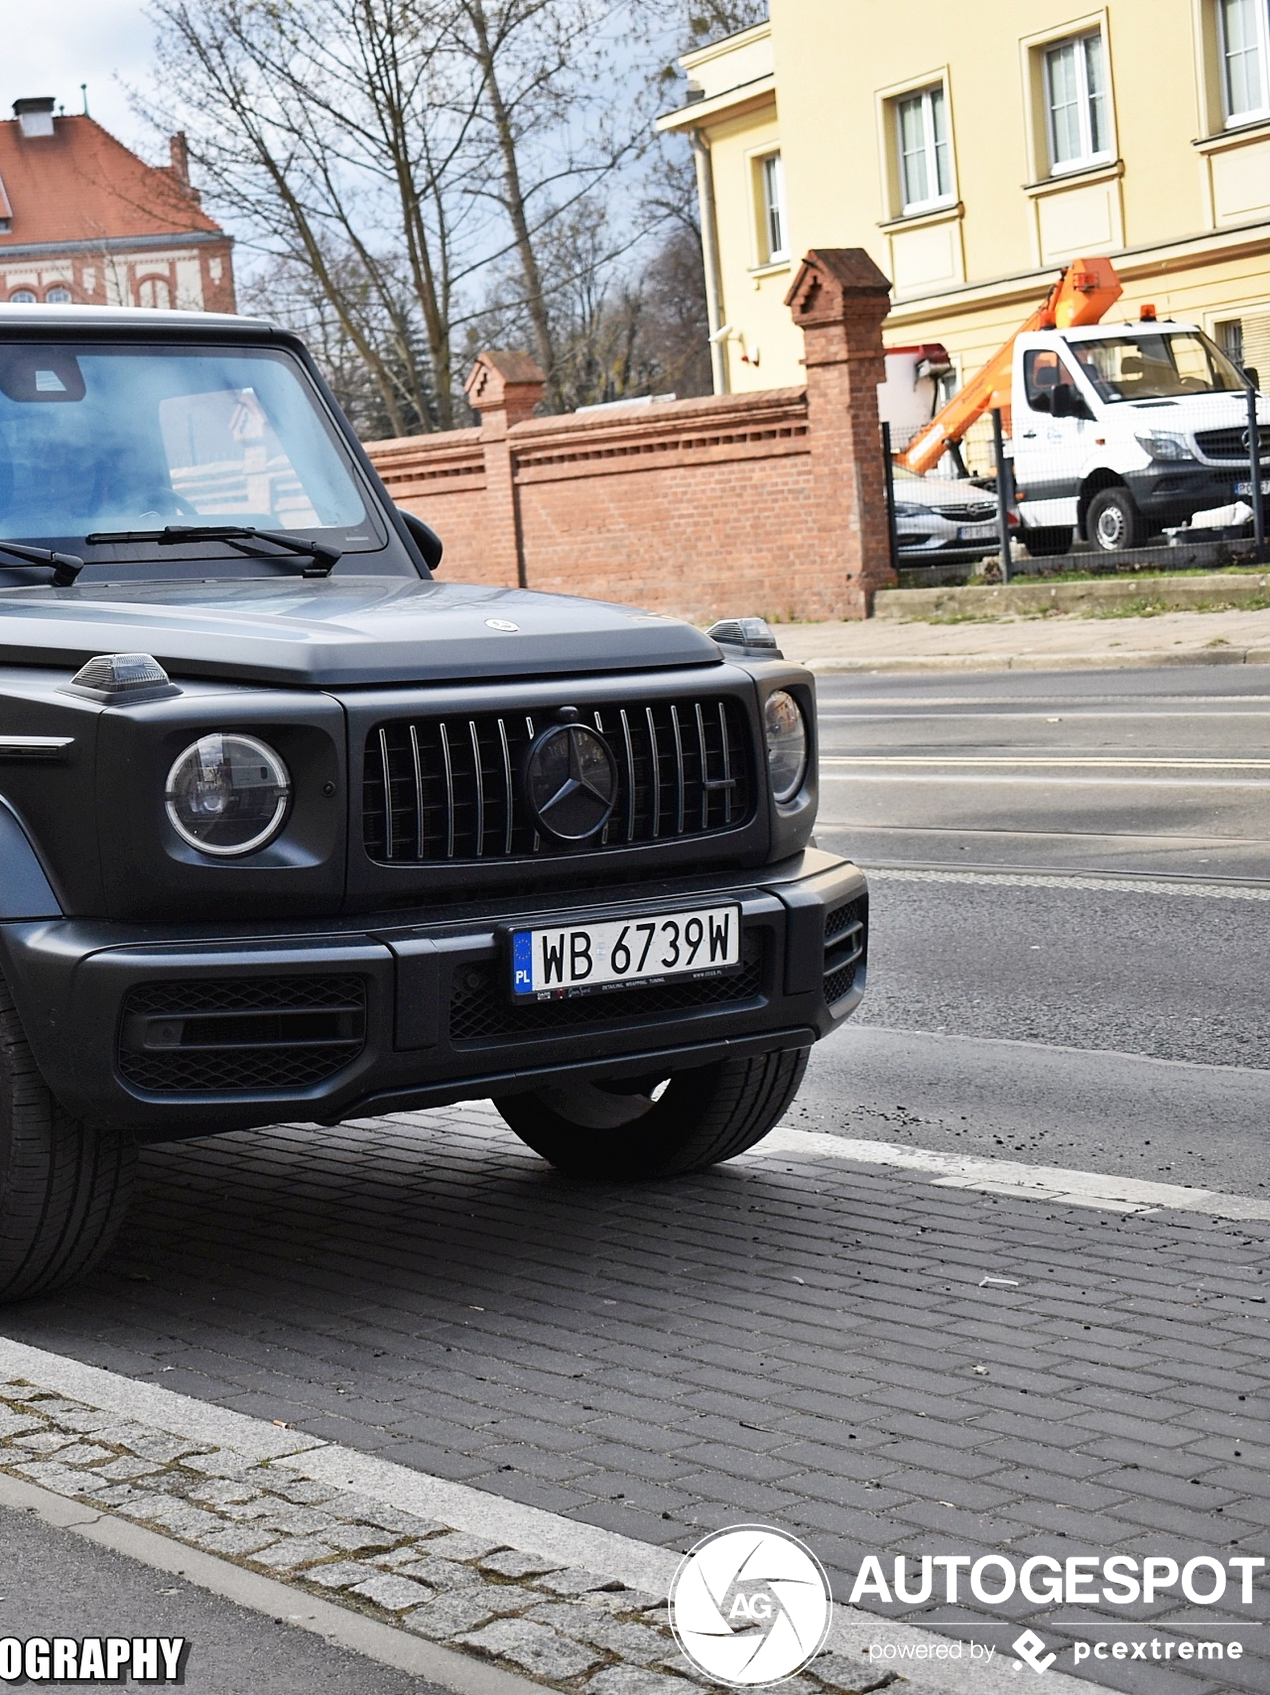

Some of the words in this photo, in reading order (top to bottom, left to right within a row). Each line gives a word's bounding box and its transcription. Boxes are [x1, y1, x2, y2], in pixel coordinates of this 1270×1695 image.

[542, 931, 594, 984] WB
[610, 913, 730, 975] 6739W
[515, 970, 530, 984] PL
